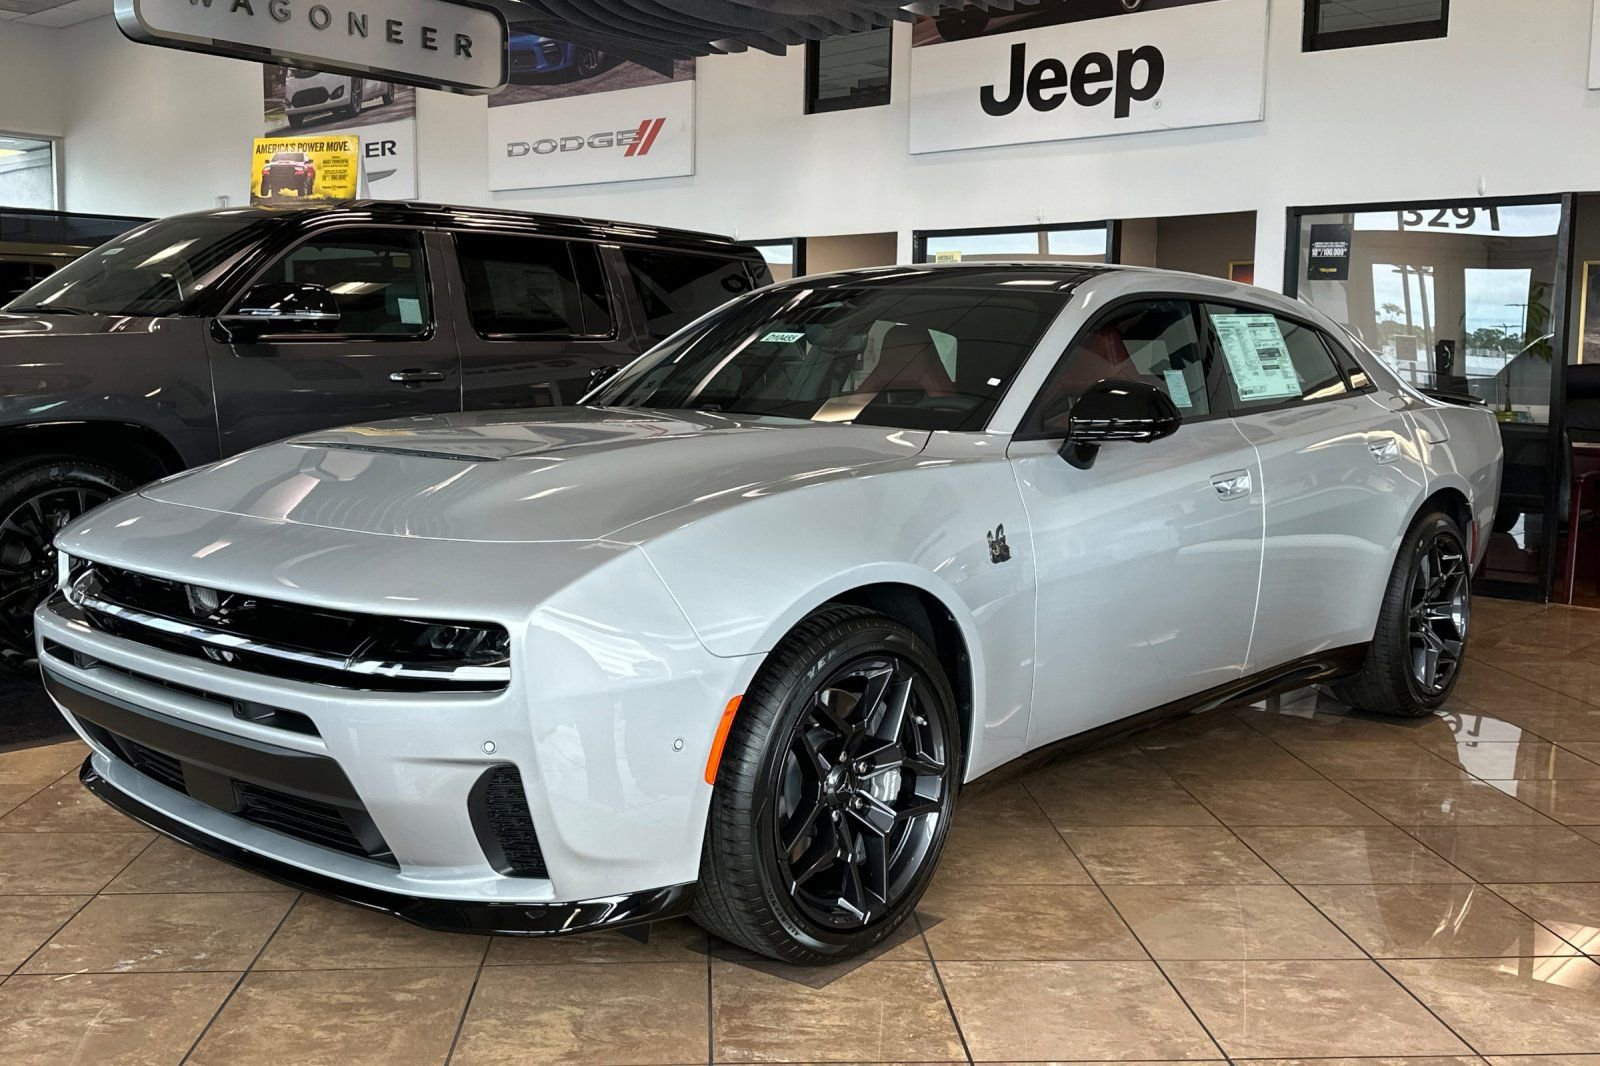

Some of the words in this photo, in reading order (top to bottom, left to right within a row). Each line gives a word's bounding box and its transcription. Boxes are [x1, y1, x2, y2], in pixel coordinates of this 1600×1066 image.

[980, 42, 1165, 119] Jeep
[256, 142, 296, 154] AMERICA'S
[297, 141, 325, 153] POWER
[507, 128, 641, 158] DODGE
